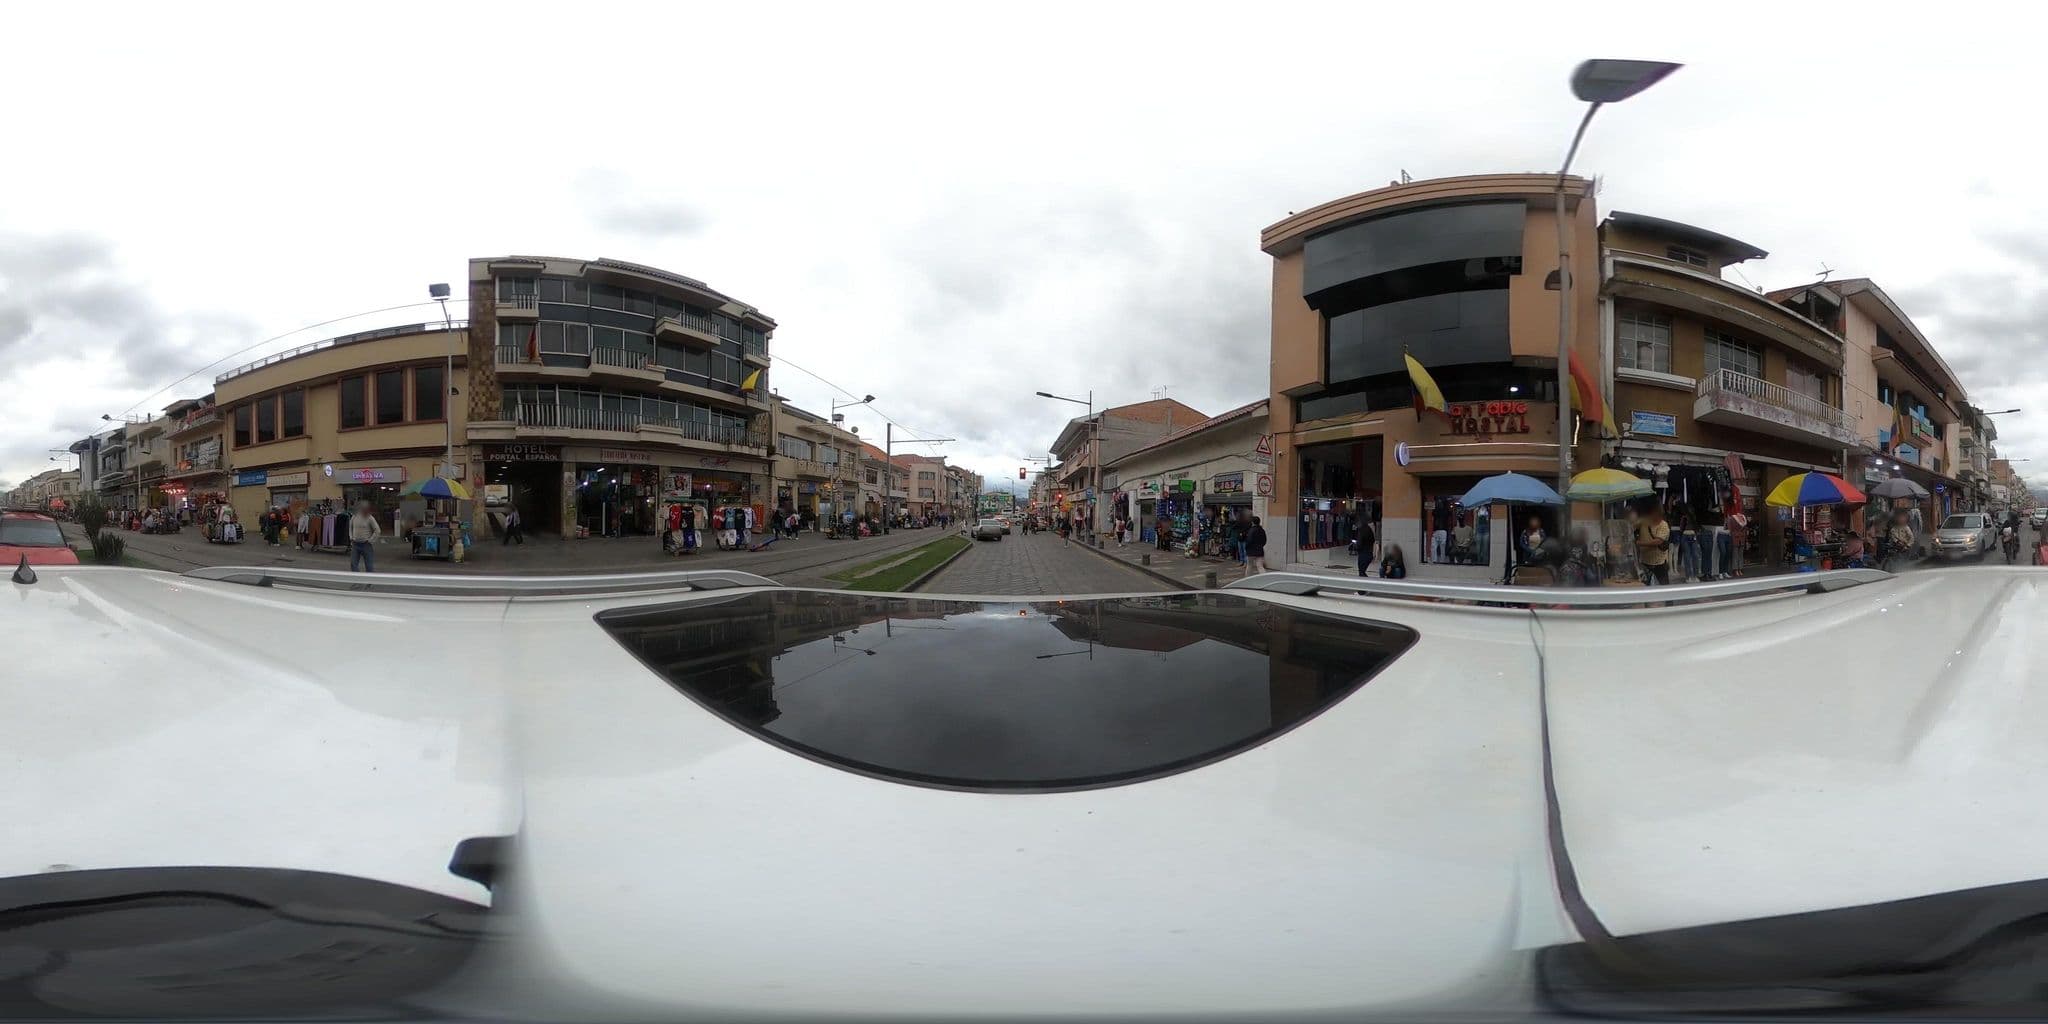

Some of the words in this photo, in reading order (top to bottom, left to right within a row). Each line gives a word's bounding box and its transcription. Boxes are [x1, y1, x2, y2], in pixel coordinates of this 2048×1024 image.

[1452, 416, 1530, 433] HOSTAL
[504, 444, 546, 453] HOTEL
[525, 453, 559, 461] ESPAÑOL
